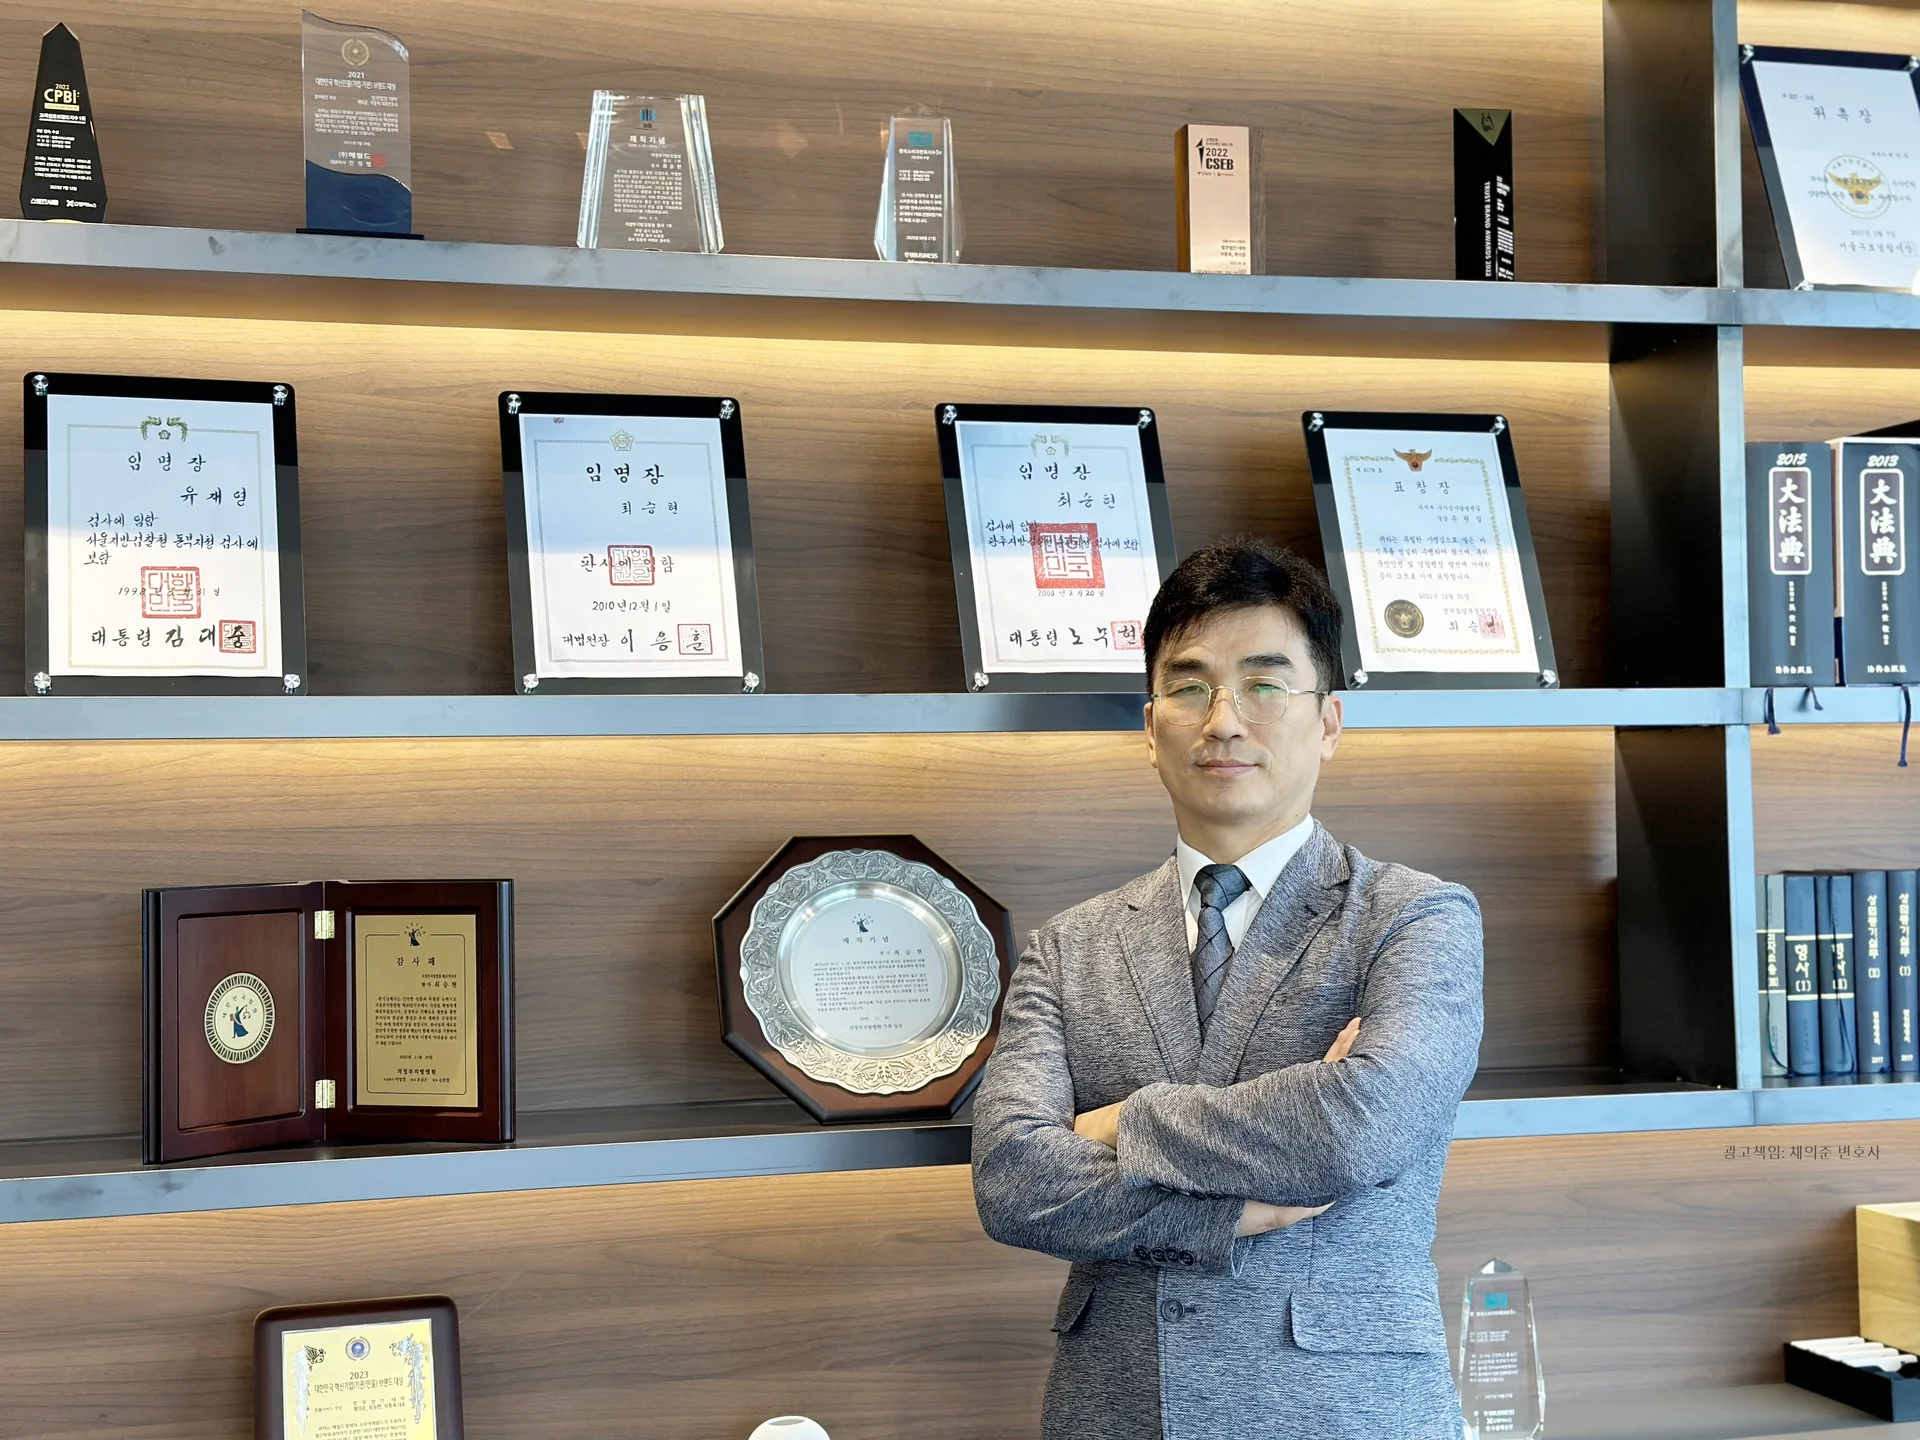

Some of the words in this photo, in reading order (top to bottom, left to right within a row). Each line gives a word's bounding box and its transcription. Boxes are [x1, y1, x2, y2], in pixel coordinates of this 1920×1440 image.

[1206, 148, 1228, 157] 2022
[1205, 158, 1234, 170] CSEB
[128, 451, 206, 472] 임명장
[1776, 453, 1808, 466] 2015
[586, 463, 664, 485] 임명장
[1019, 462, 1091, 480] 임명장
[1394, 480, 1450, 495] 표창장
[1057, 492, 1116, 509] 최승현
[88, 512, 125, 528] 검사에
[133, 511, 158, 528] 임함
[1778, 477, 1806, 564] 大法典
[1870, 478, 1898, 565] 大法典
[86, 532, 168, 548] 서울지방검찰청
[174, 533, 214, 550] 동부지청
[220, 534, 258, 552] 검사에
[84, 551, 112, 566] 보함
[91, 626, 150, 648] 대통령
[562, 634, 610, 648] 대법원장
[1009, 628, 1058, 648] 대통령
[350, 1371, 369, 1379] 2023
